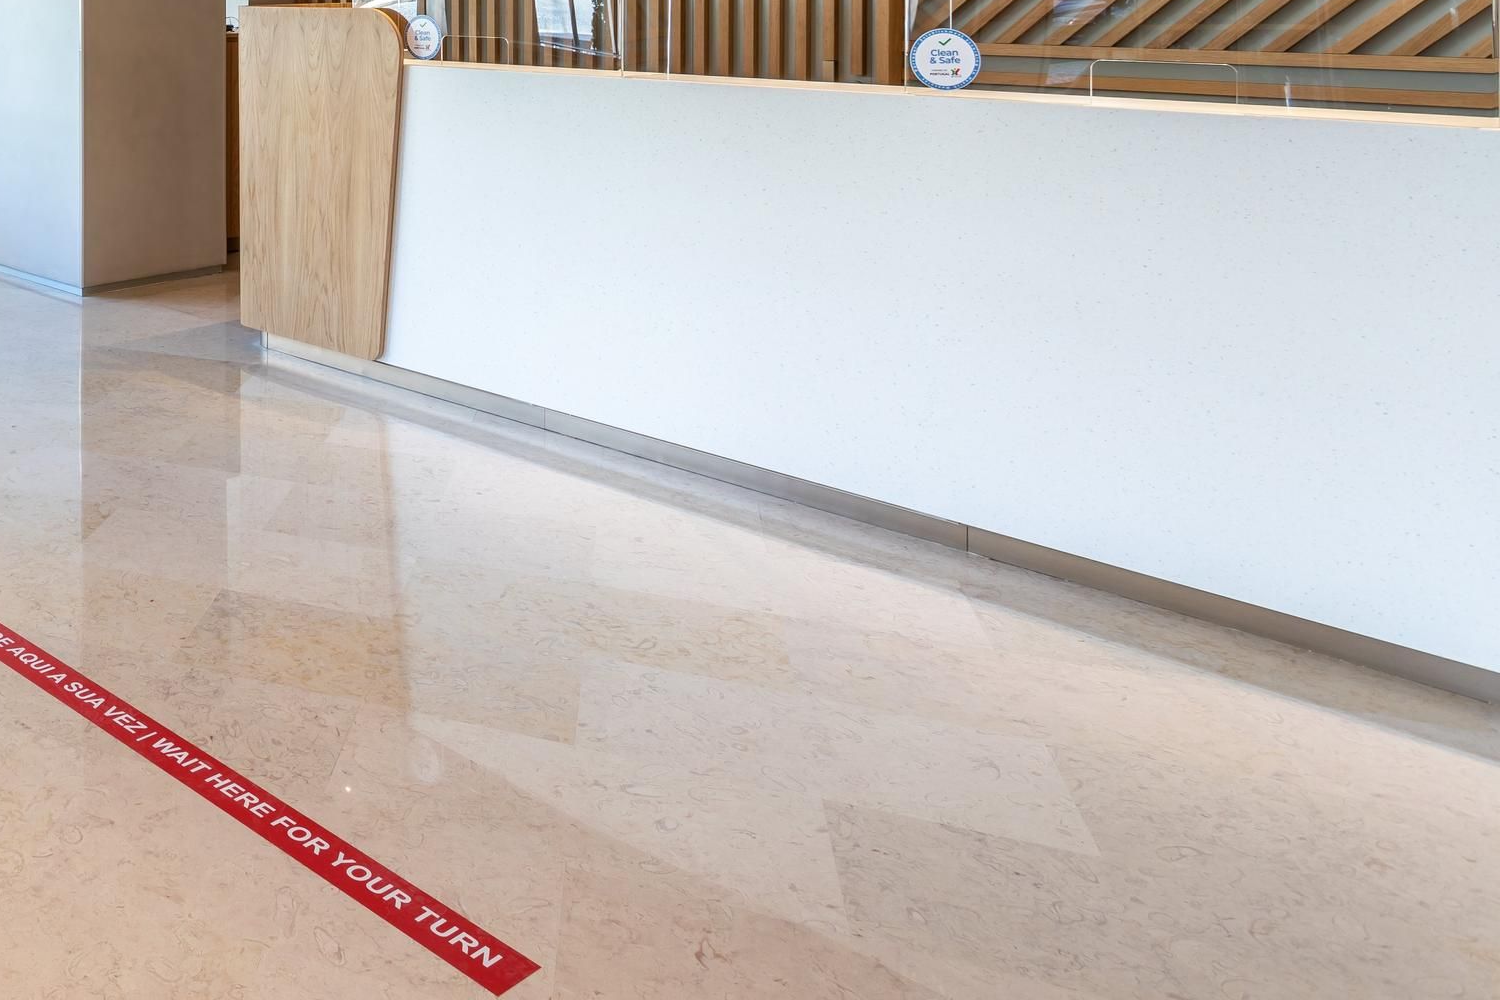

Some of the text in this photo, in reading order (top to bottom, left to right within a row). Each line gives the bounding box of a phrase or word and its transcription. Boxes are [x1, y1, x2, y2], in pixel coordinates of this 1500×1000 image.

[939, 56, 961, 64] Safe
[7, 647, 55, 673] AQUI
[47, 673, 66, 684] A
[64, 682, 105, 709] SUA
[104, 706, 148, 734] VEZ
[152, 737, 212, 774] WAIT
[205, 774, 276, 819] HERE
[270, 815, 330, 855] FOR
[330, 852, 412, 910] YOUR
[414, 906, 503, 968] TURN
